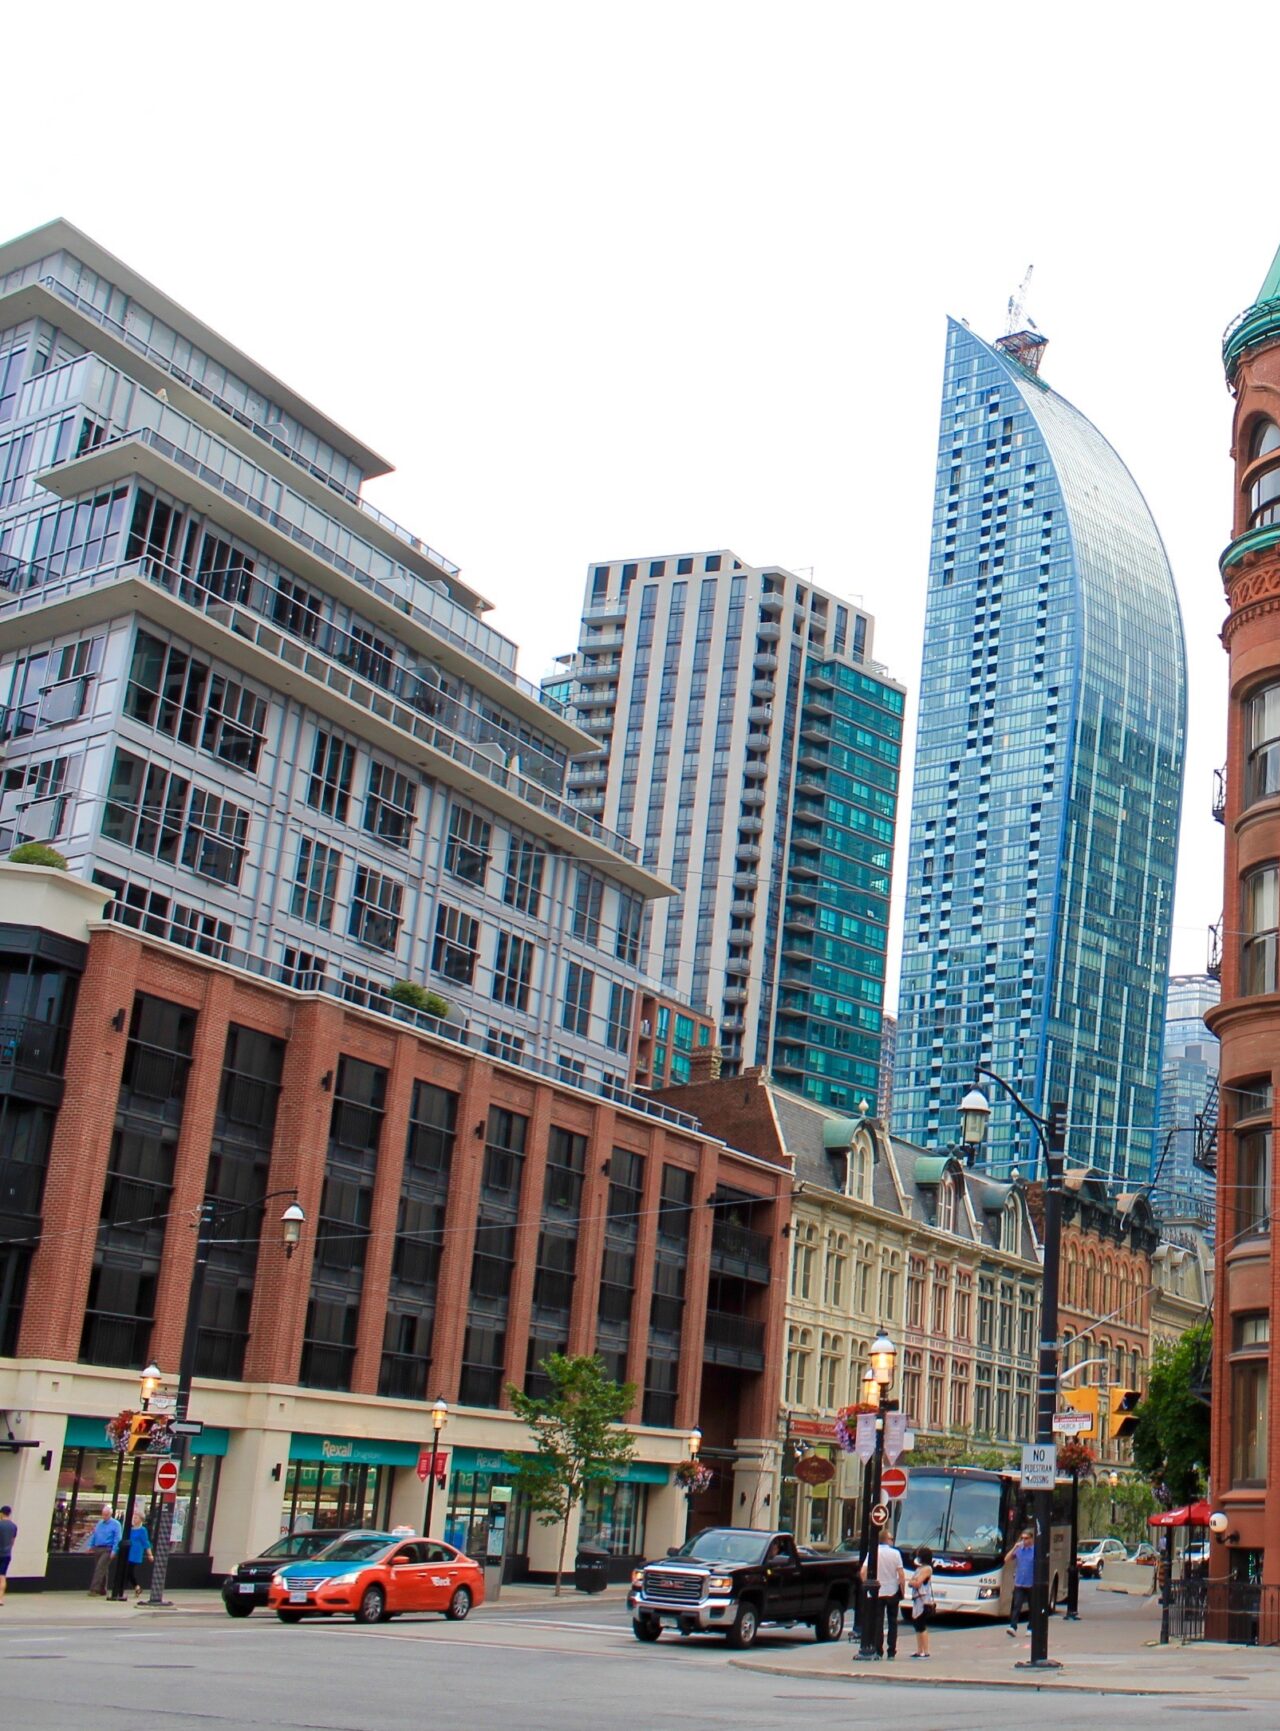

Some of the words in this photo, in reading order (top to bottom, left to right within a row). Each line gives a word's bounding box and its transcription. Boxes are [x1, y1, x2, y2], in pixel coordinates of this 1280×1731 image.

[322, 1440, 352, 1458] Rexall
[1033, 1450, 1045, 1461] NO
[1025, 1463, 1052, 1473] PEDESTRIAN
[979, 1577, 997, 1585] 4555
